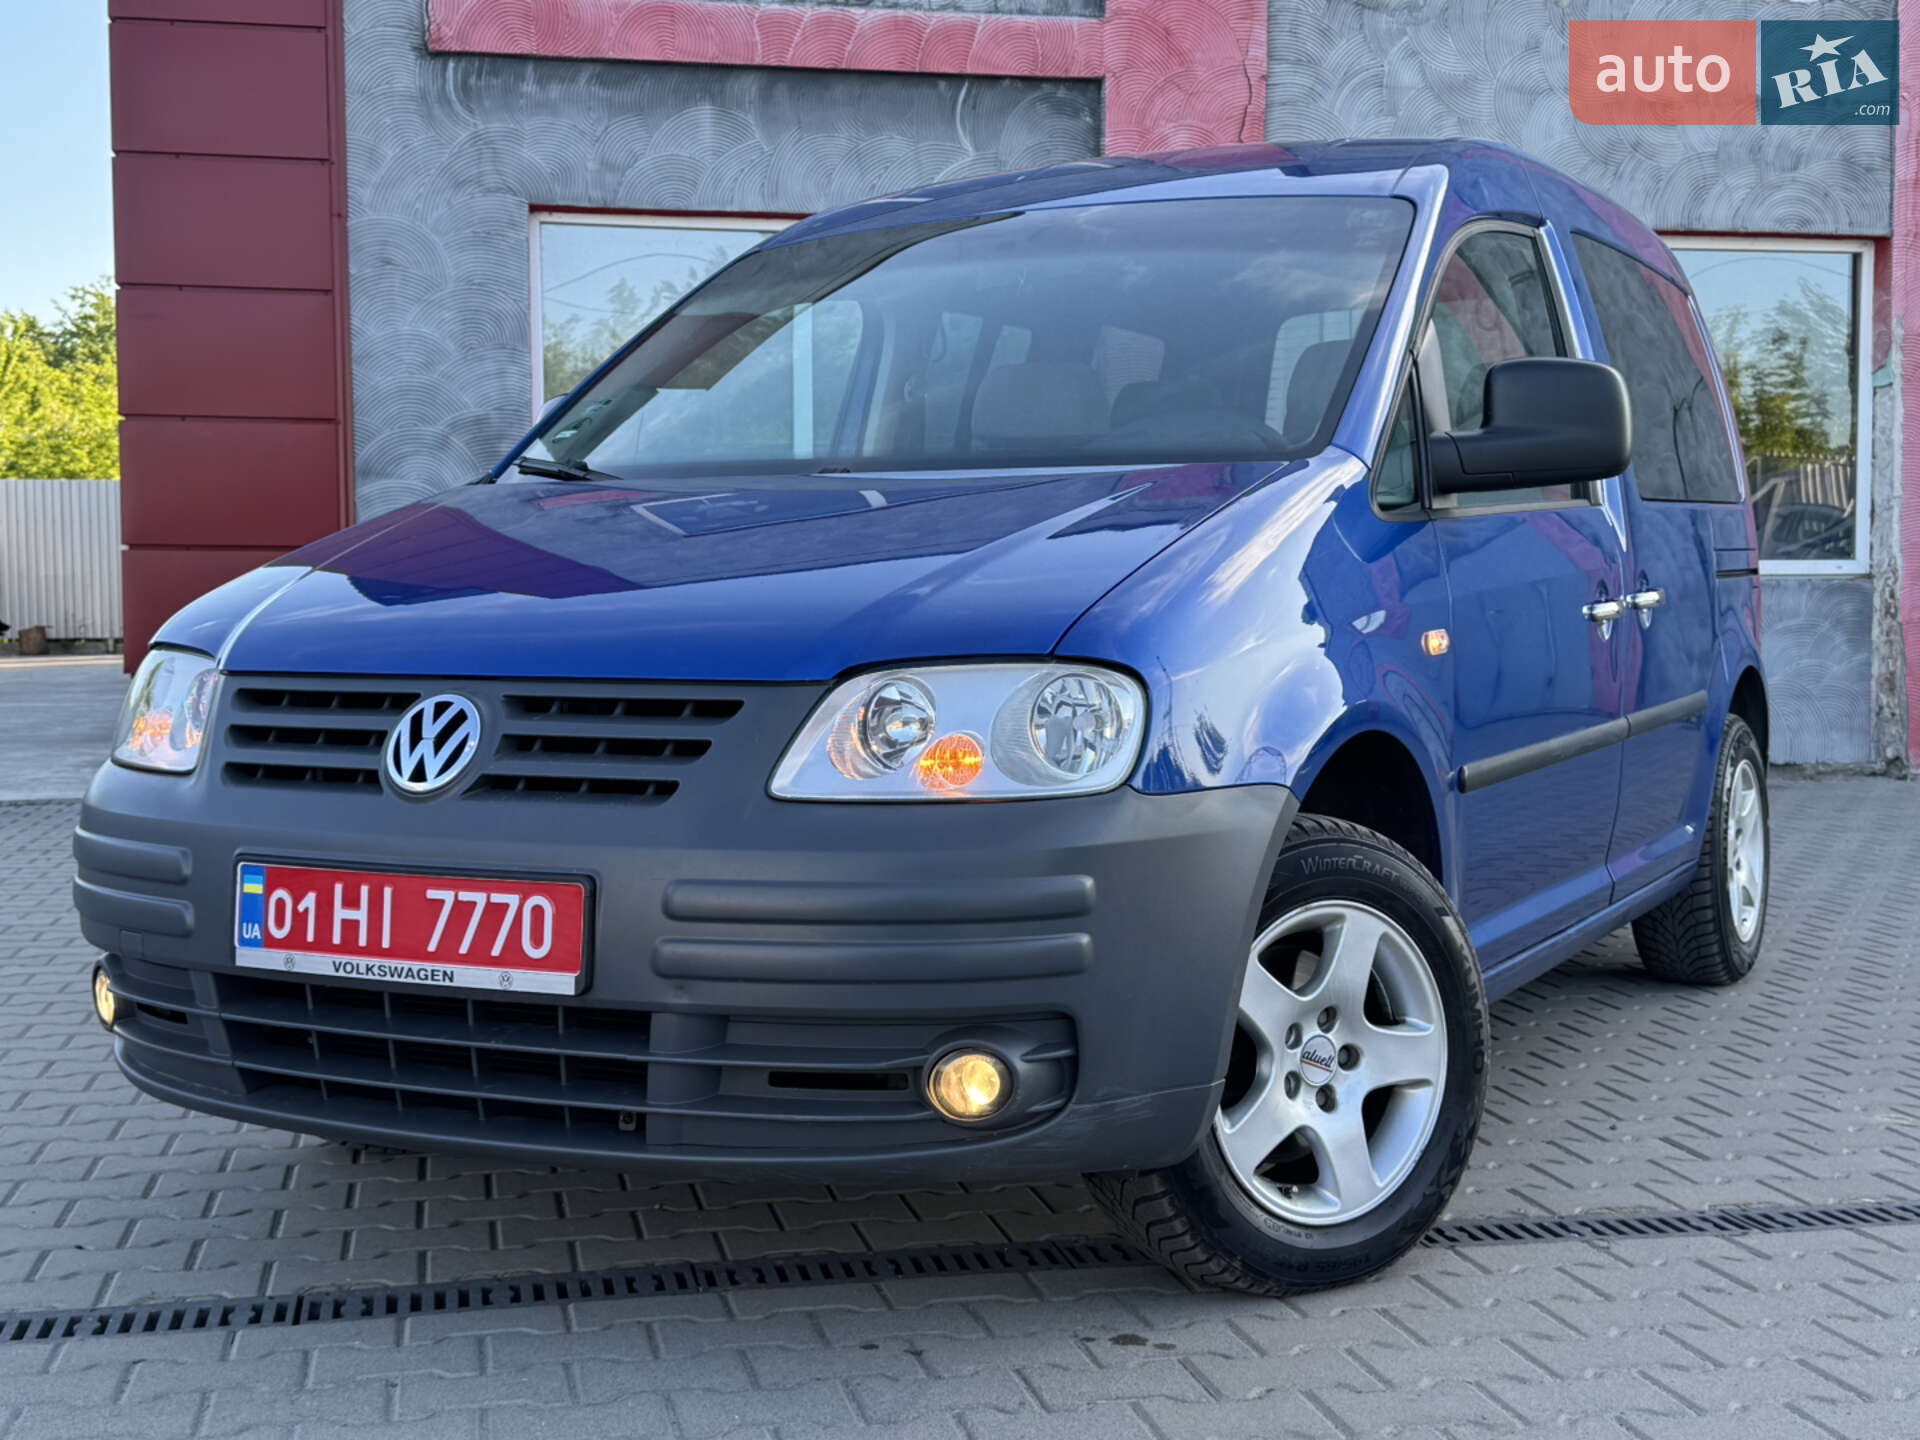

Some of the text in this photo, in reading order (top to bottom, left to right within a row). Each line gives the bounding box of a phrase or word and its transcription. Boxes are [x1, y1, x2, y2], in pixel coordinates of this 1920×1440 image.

[242, 922, 261, 939] UA
[267, 882, 552, 960] 01 HI 7770
[332, 959, 454, 984] VOLKSWAGEN
